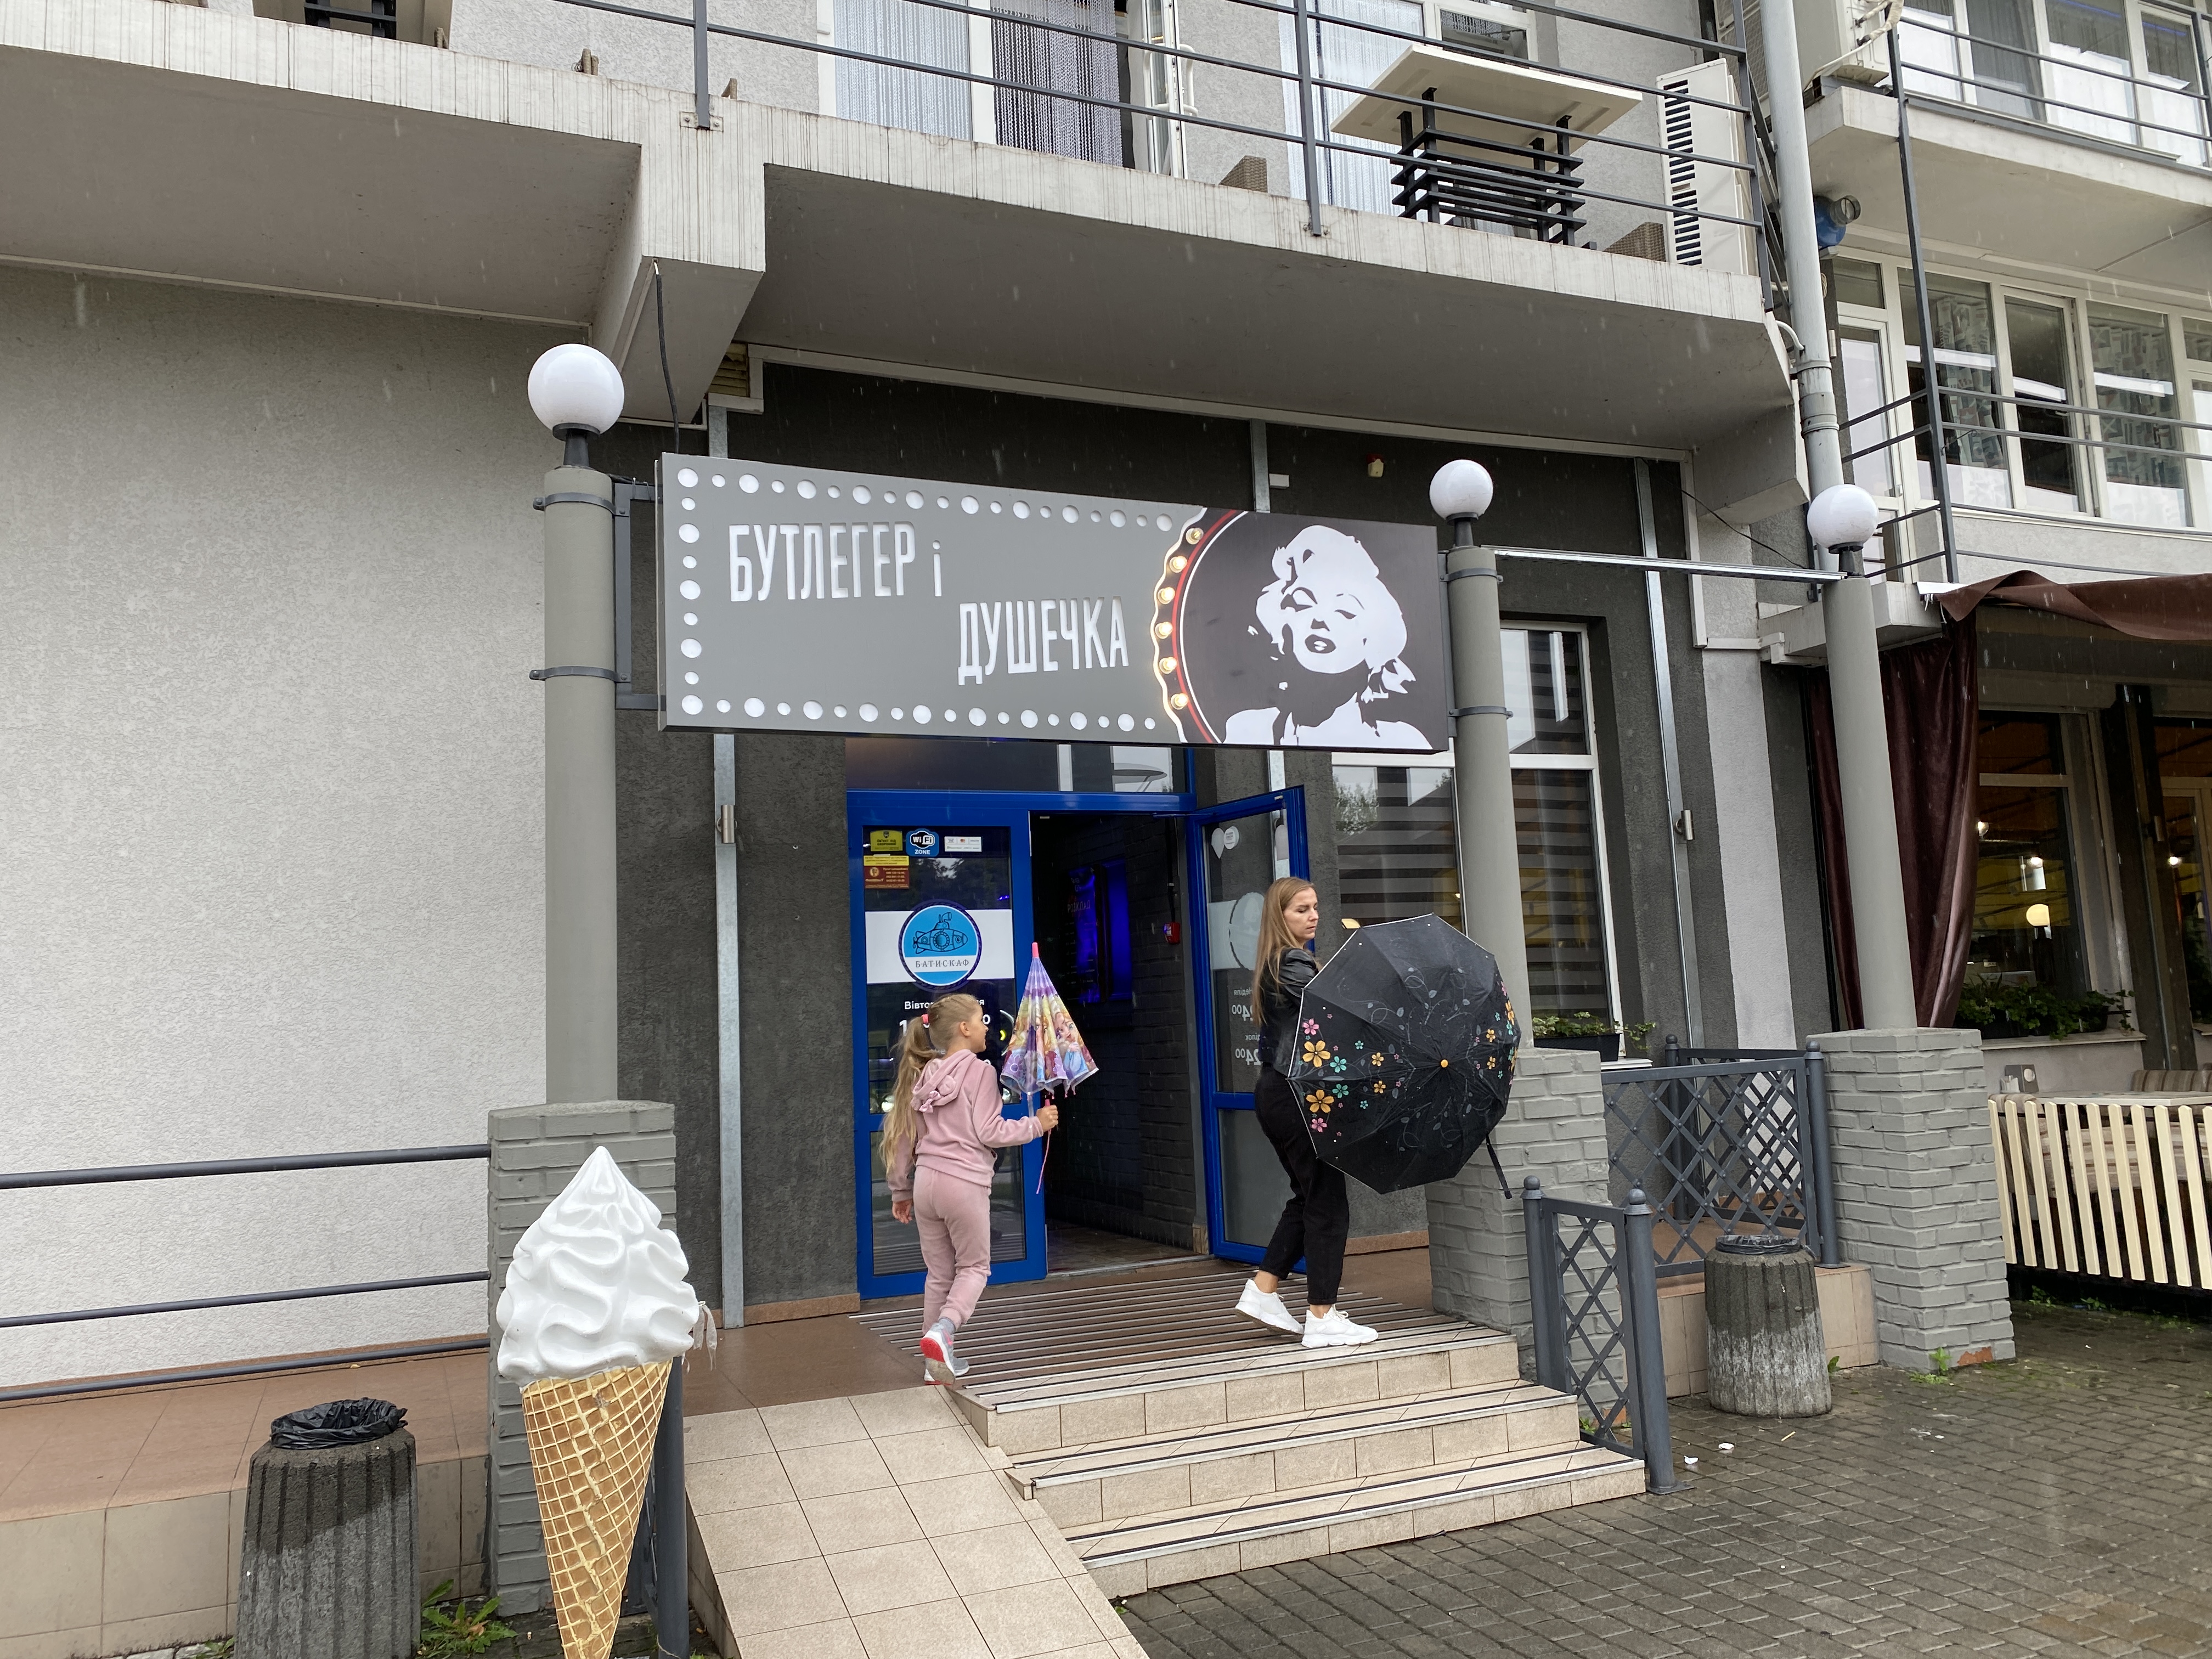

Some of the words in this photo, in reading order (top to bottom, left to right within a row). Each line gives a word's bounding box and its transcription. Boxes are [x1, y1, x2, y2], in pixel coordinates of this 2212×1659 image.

[729, 521, 916, 602] БУТЛЕГЕР
[957, 596, 1130, 686] ДУШЕЧКА
[904, 1001, 933, 1010] Вівто
